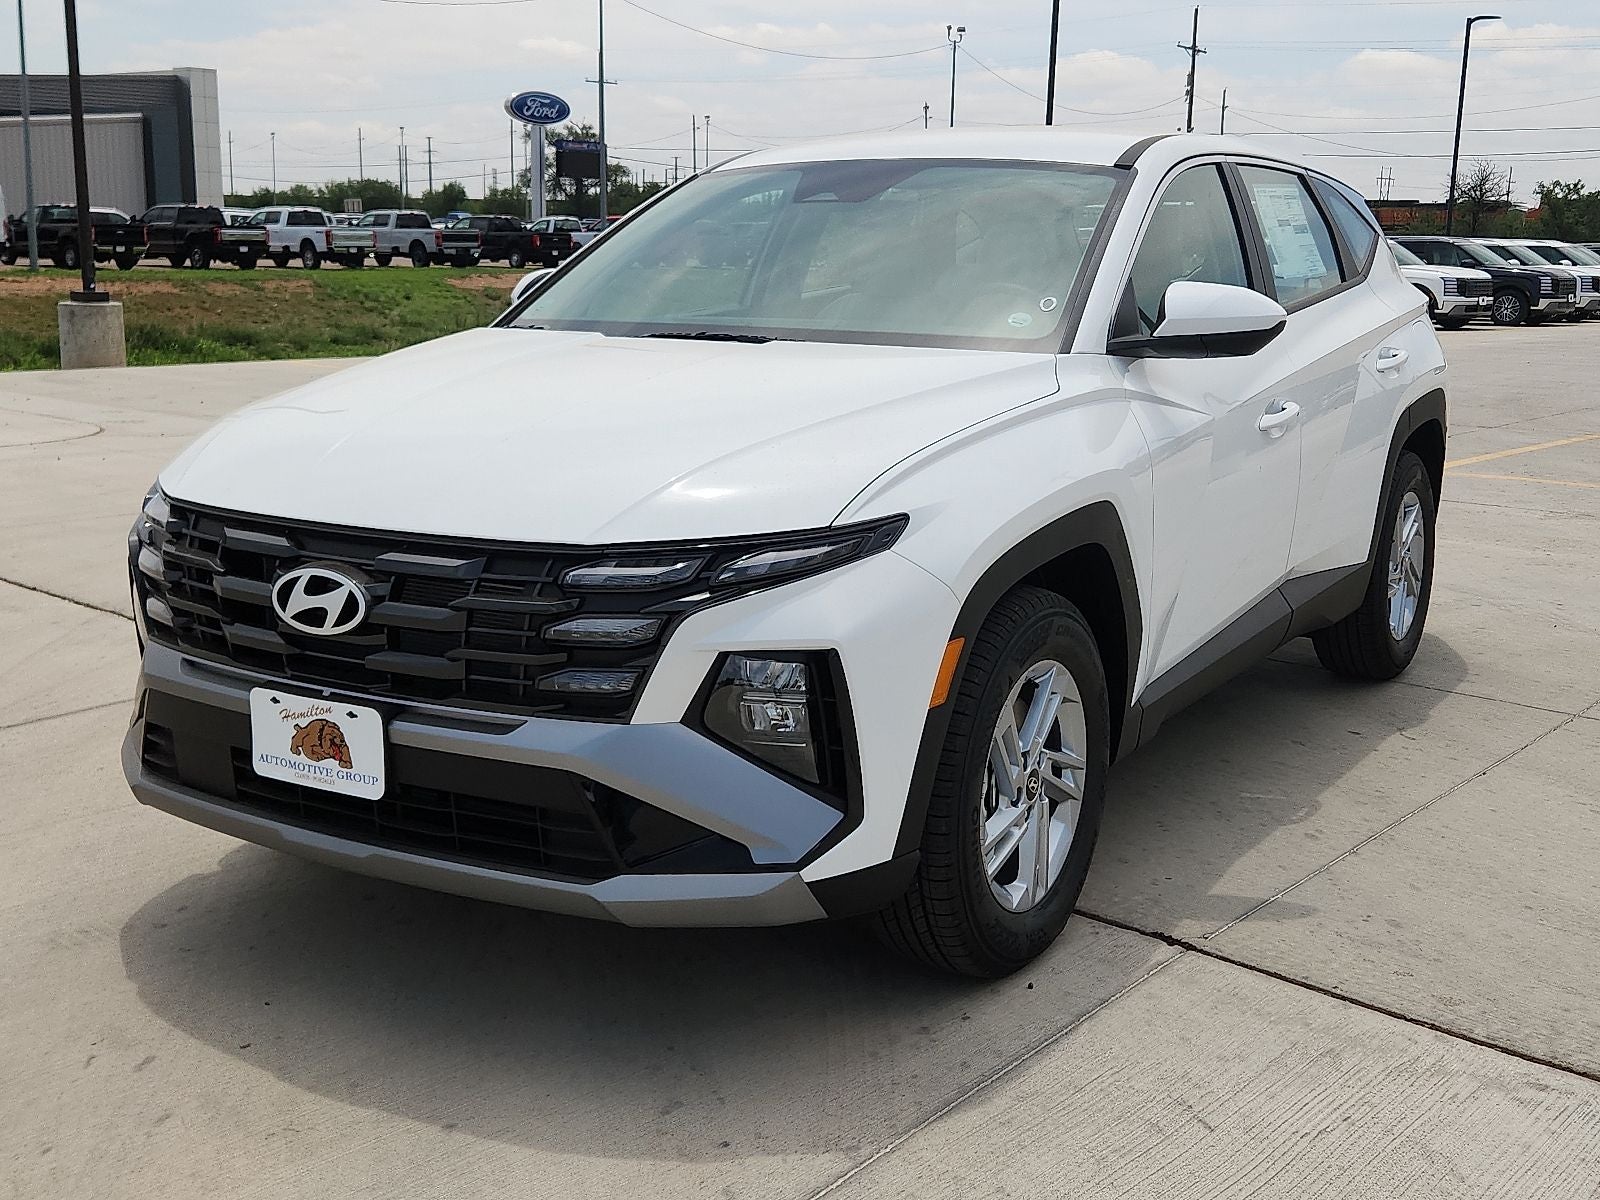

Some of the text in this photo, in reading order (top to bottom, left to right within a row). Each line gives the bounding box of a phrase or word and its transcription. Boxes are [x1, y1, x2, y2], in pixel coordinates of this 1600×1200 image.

[523, 97, 560, 119] Ford
[279, 704, 334, 722] Hamilton
[258, 753, 334, 778] AUTOMOTIVE
[336, 769, 379, 786] GROUP
